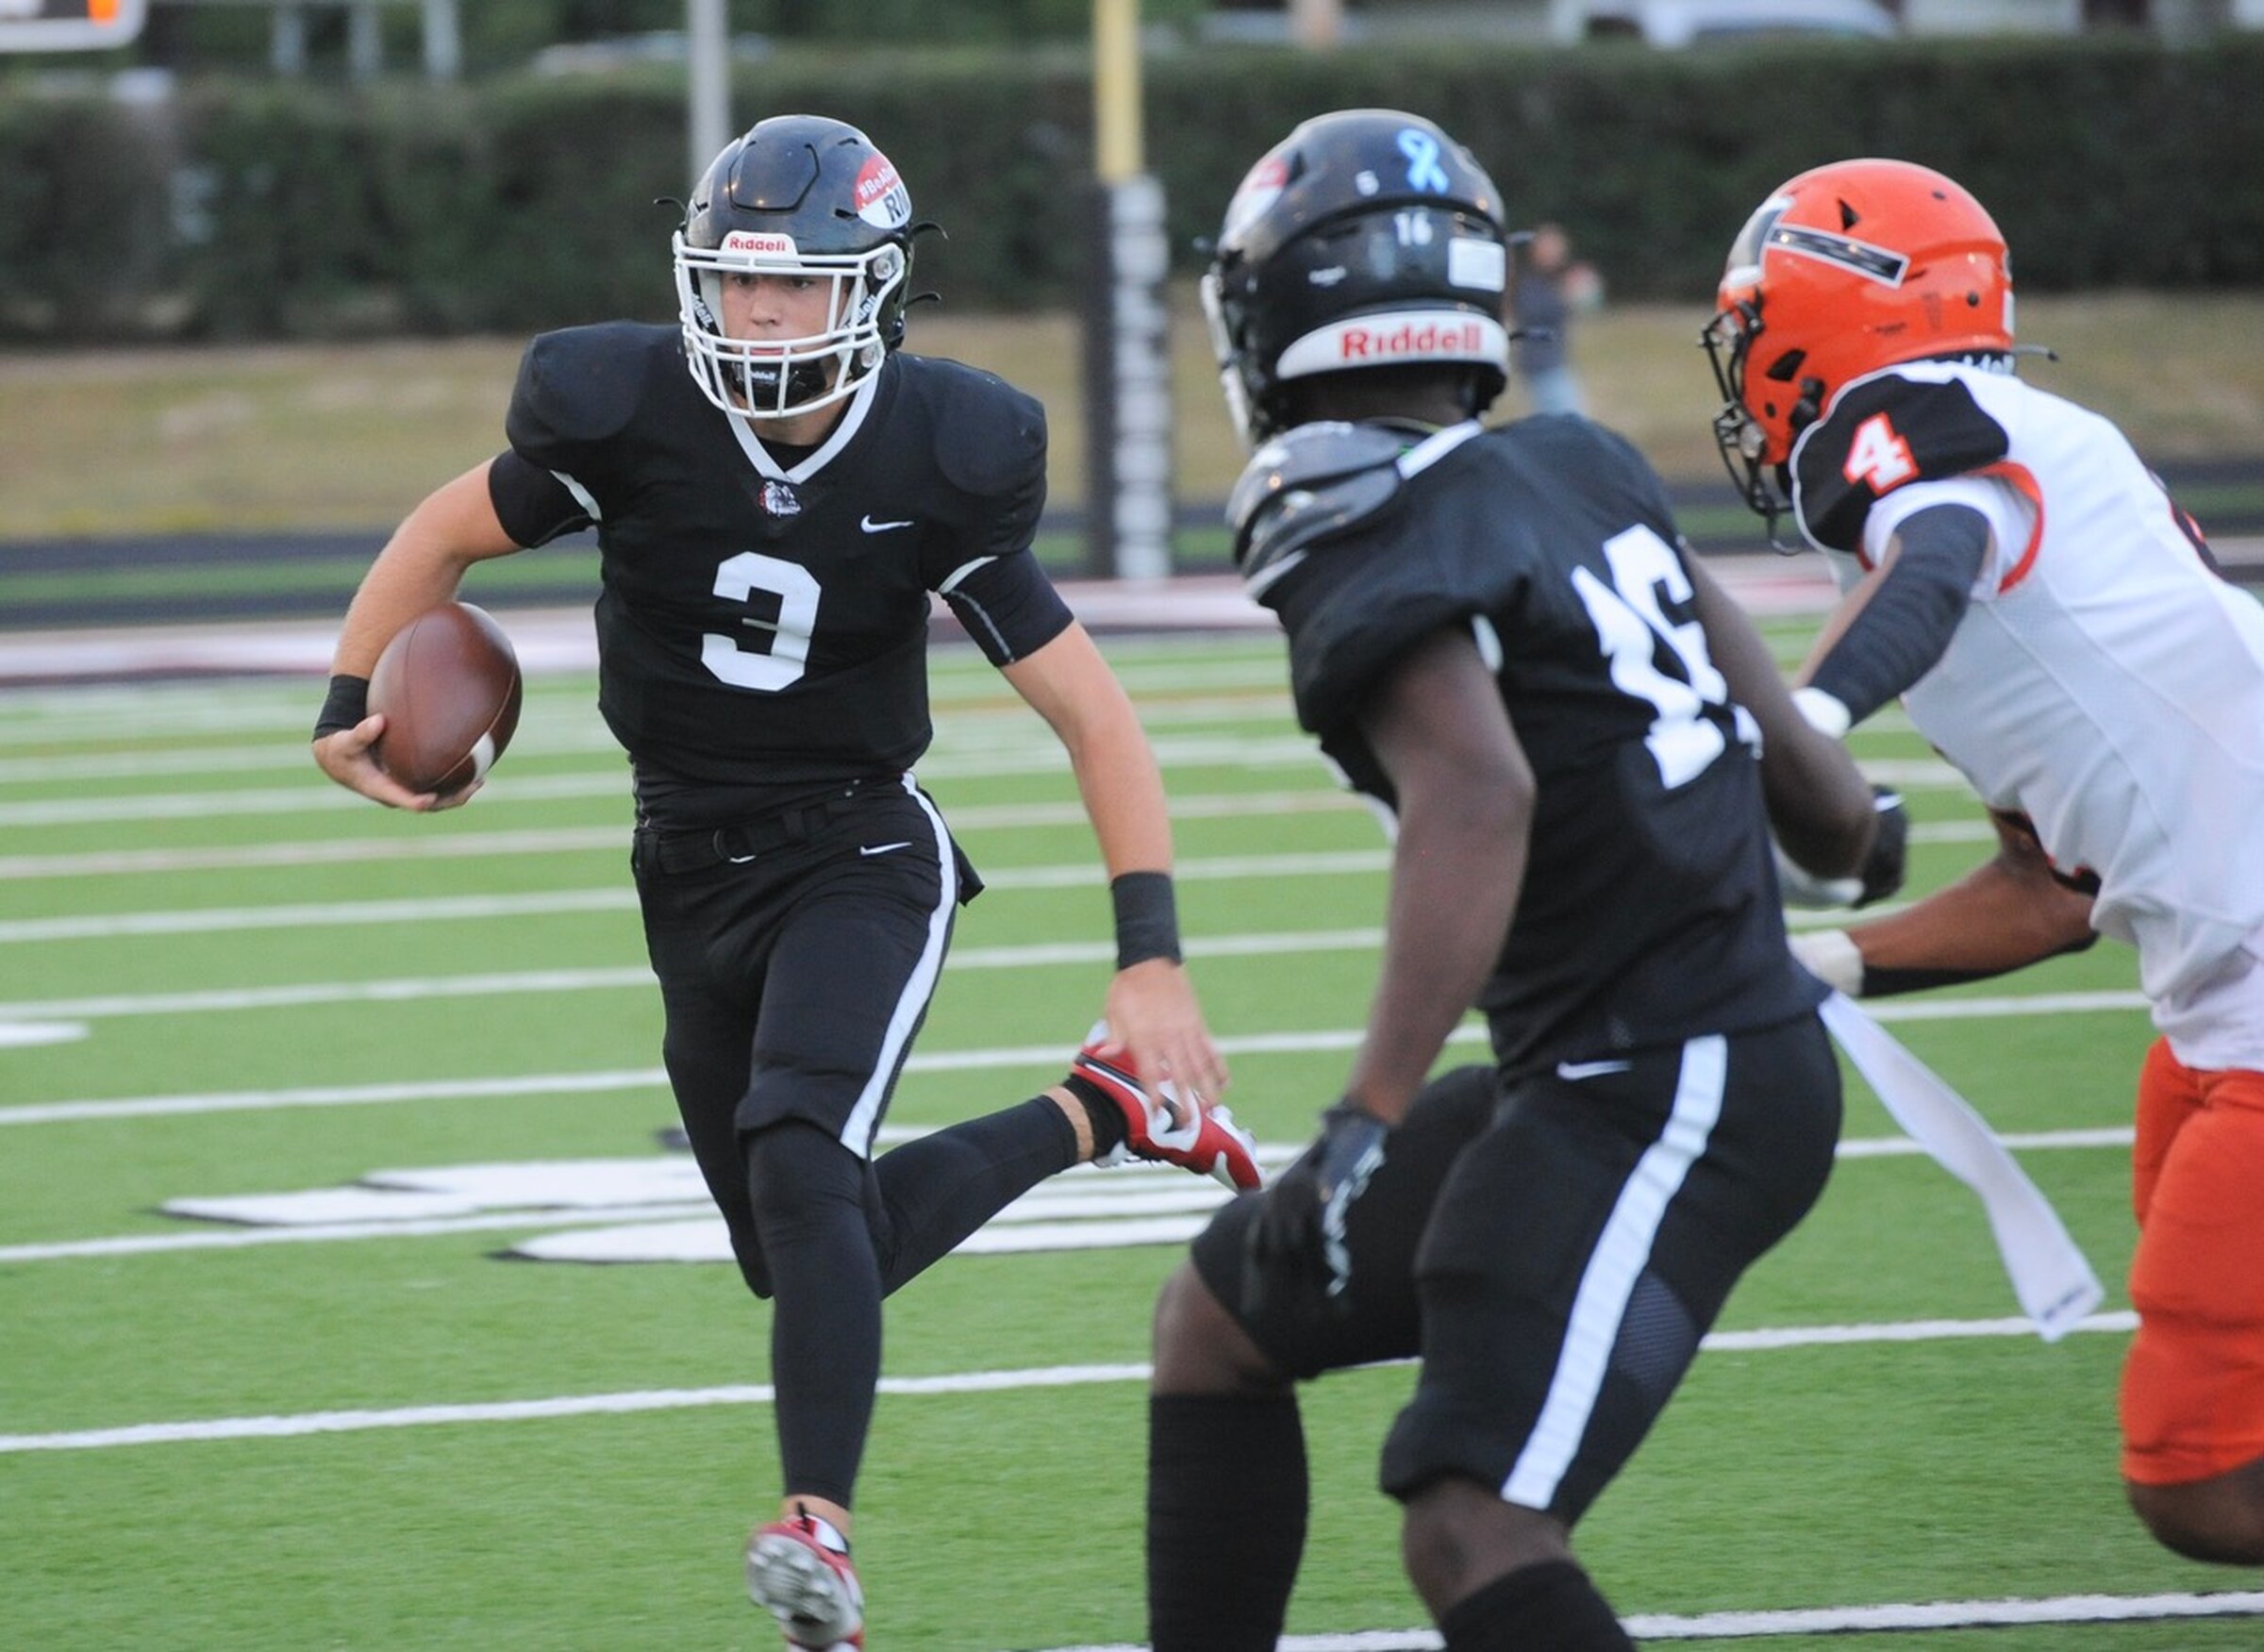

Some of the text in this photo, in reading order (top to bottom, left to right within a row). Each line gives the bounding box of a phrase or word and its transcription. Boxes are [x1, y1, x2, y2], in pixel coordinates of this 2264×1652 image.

[729, 237, 786, 252] Riddell
[1342, 325, 1481, 358] Riddell
[1842, 421, 1920, 496] 4
[701, 551, 822, 692] 3
